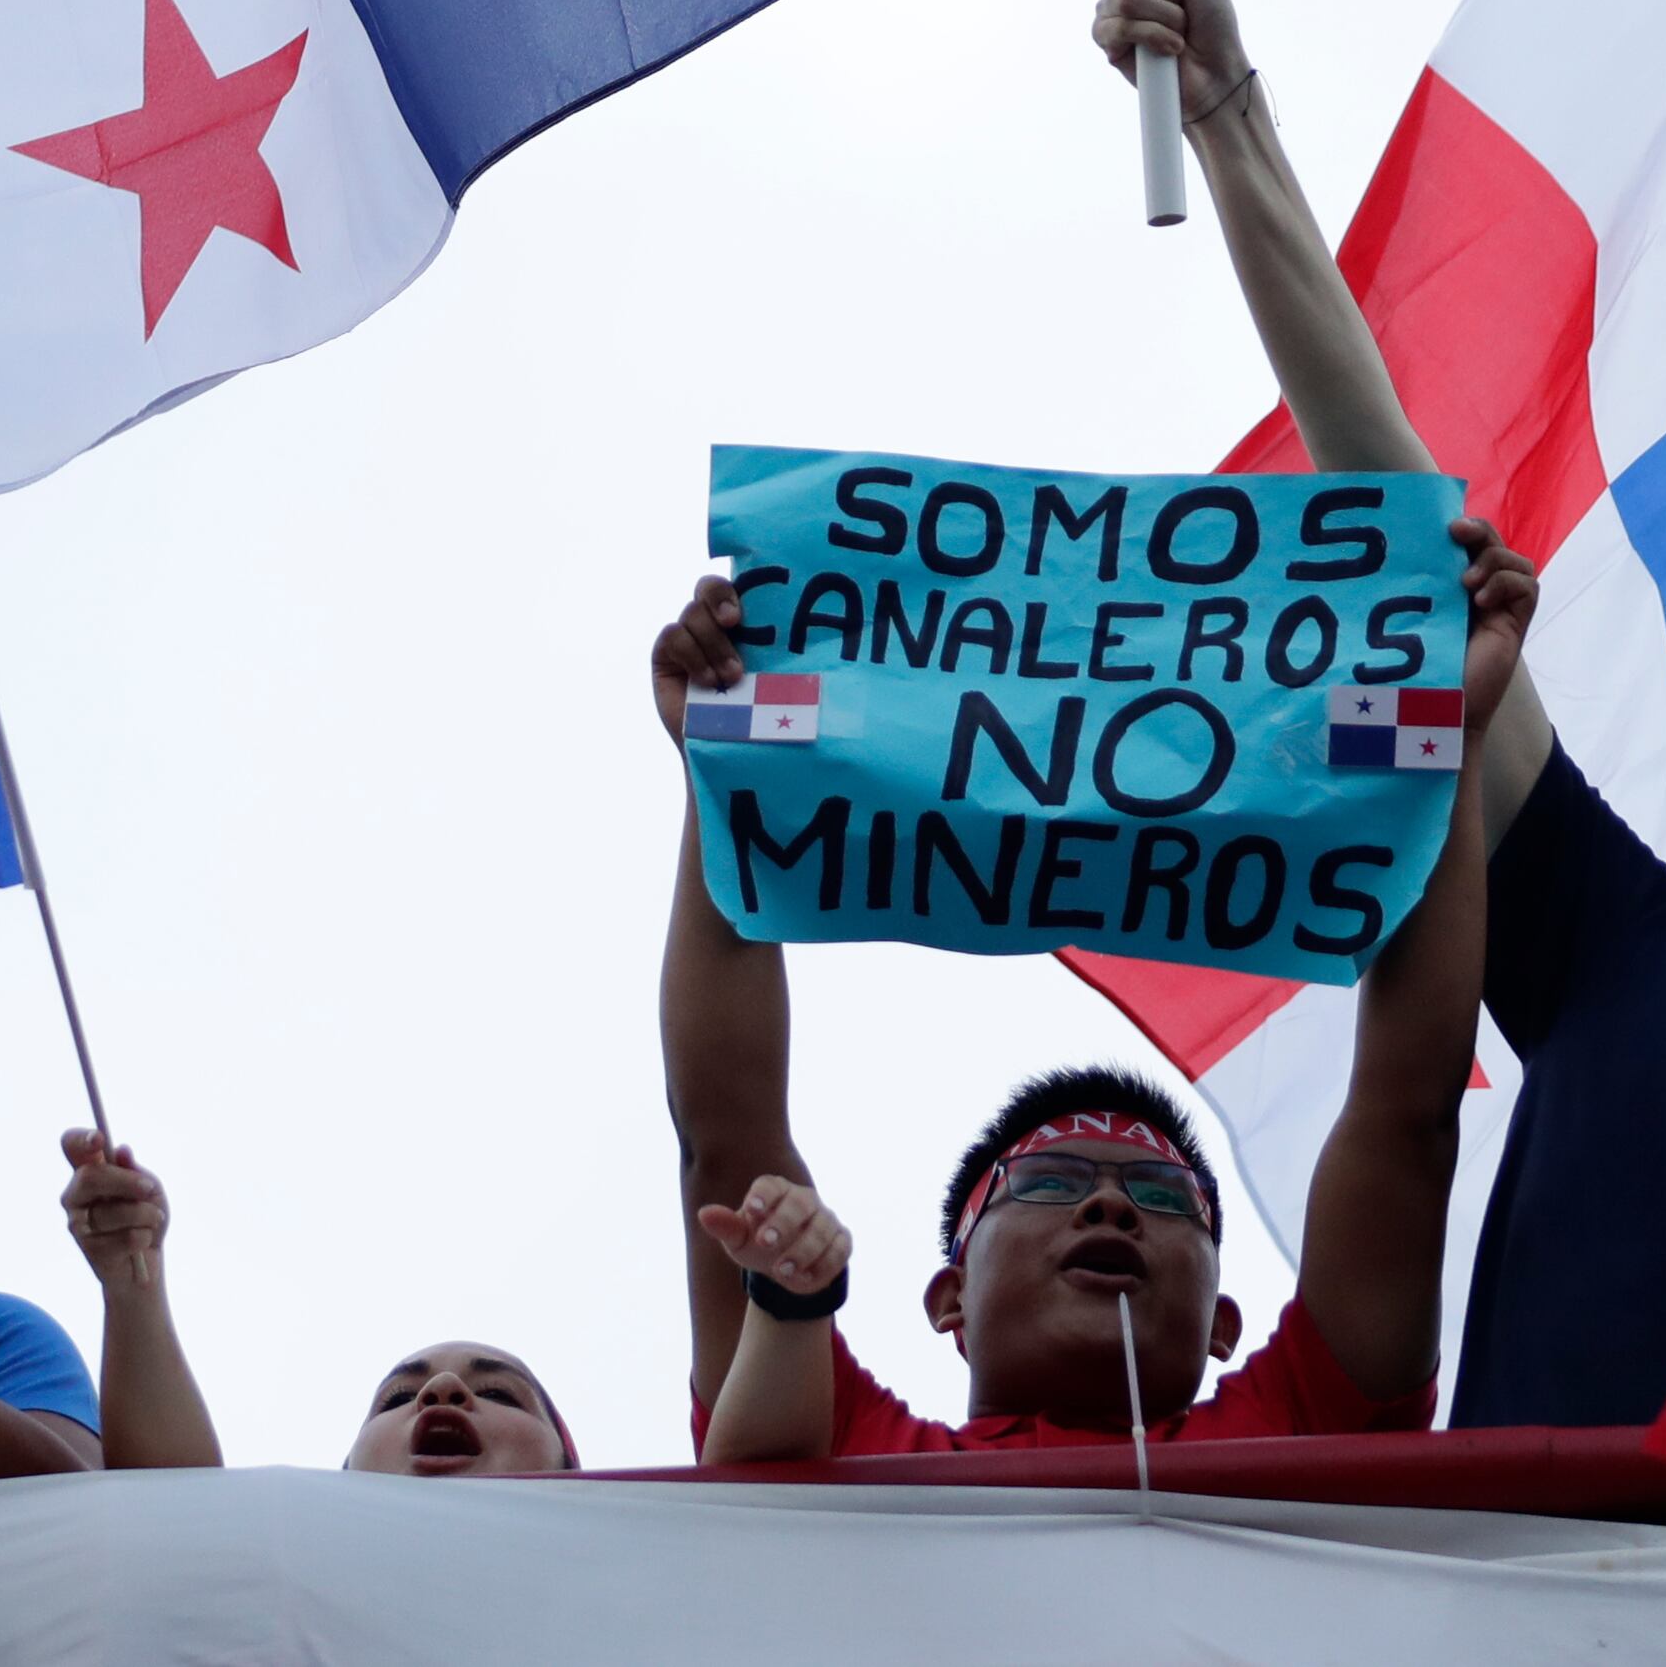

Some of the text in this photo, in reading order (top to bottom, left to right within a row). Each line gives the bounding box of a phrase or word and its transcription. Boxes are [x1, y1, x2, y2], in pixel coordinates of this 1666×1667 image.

[827, 467, 1388, 585] SOMOS
[729, 564, 1434, 687] CANALEROS
[940, 688, 1237, 819] NO
[728, 788, 1395, 957] MINEROS
